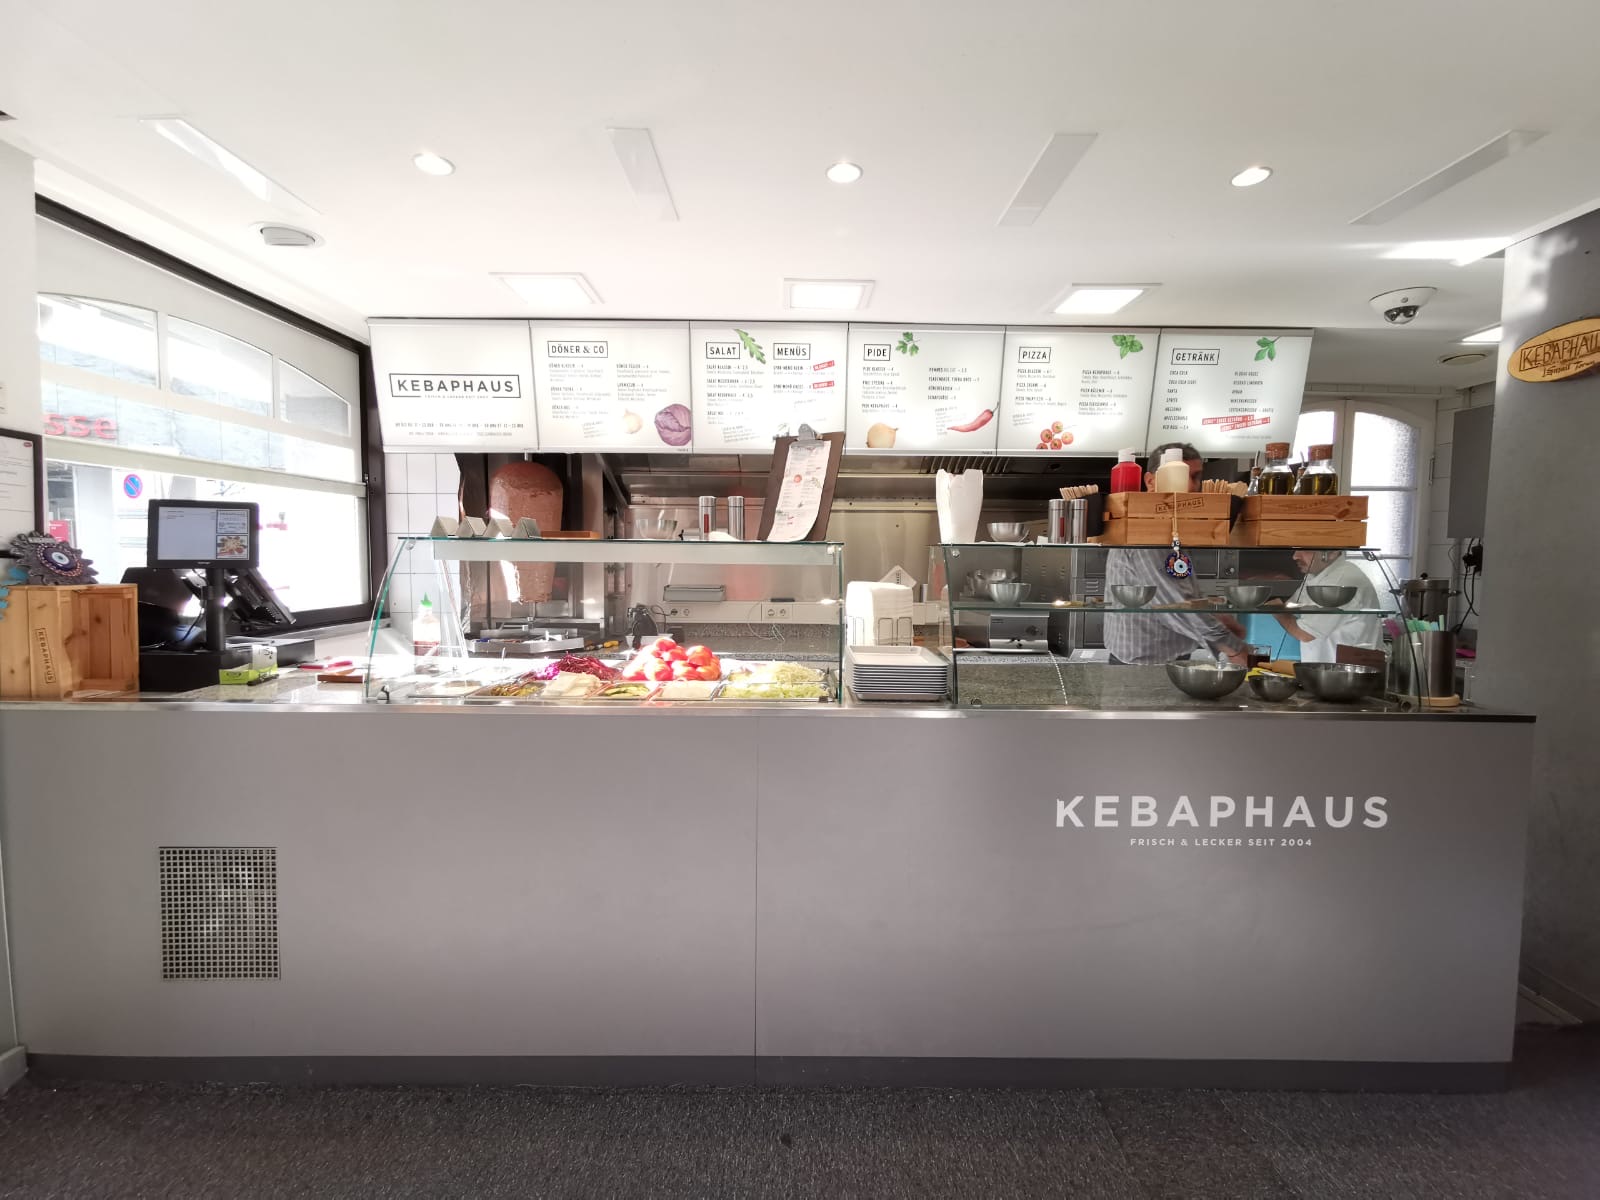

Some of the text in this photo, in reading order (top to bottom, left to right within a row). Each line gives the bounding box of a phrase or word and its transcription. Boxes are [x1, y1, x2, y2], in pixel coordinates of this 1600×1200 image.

[551, 344, 605, 354] DÖNER & CO
[709, 346, 737, 355] SALAT
[776, 347, 807, 356] MENÜS
[867, 348, 887, 357] PIDE
[1022, 351, 1047, 360] PIZZA
[1175, 352, 1215, 361] GETRÄNK
[397, 379, 513, 392] KEBAPHAUS
[1055, 795, 1389, 828] KEBAPHAUS
[1130, 838, 1313, 847] FRISCH & LECKER SEIT 2004
